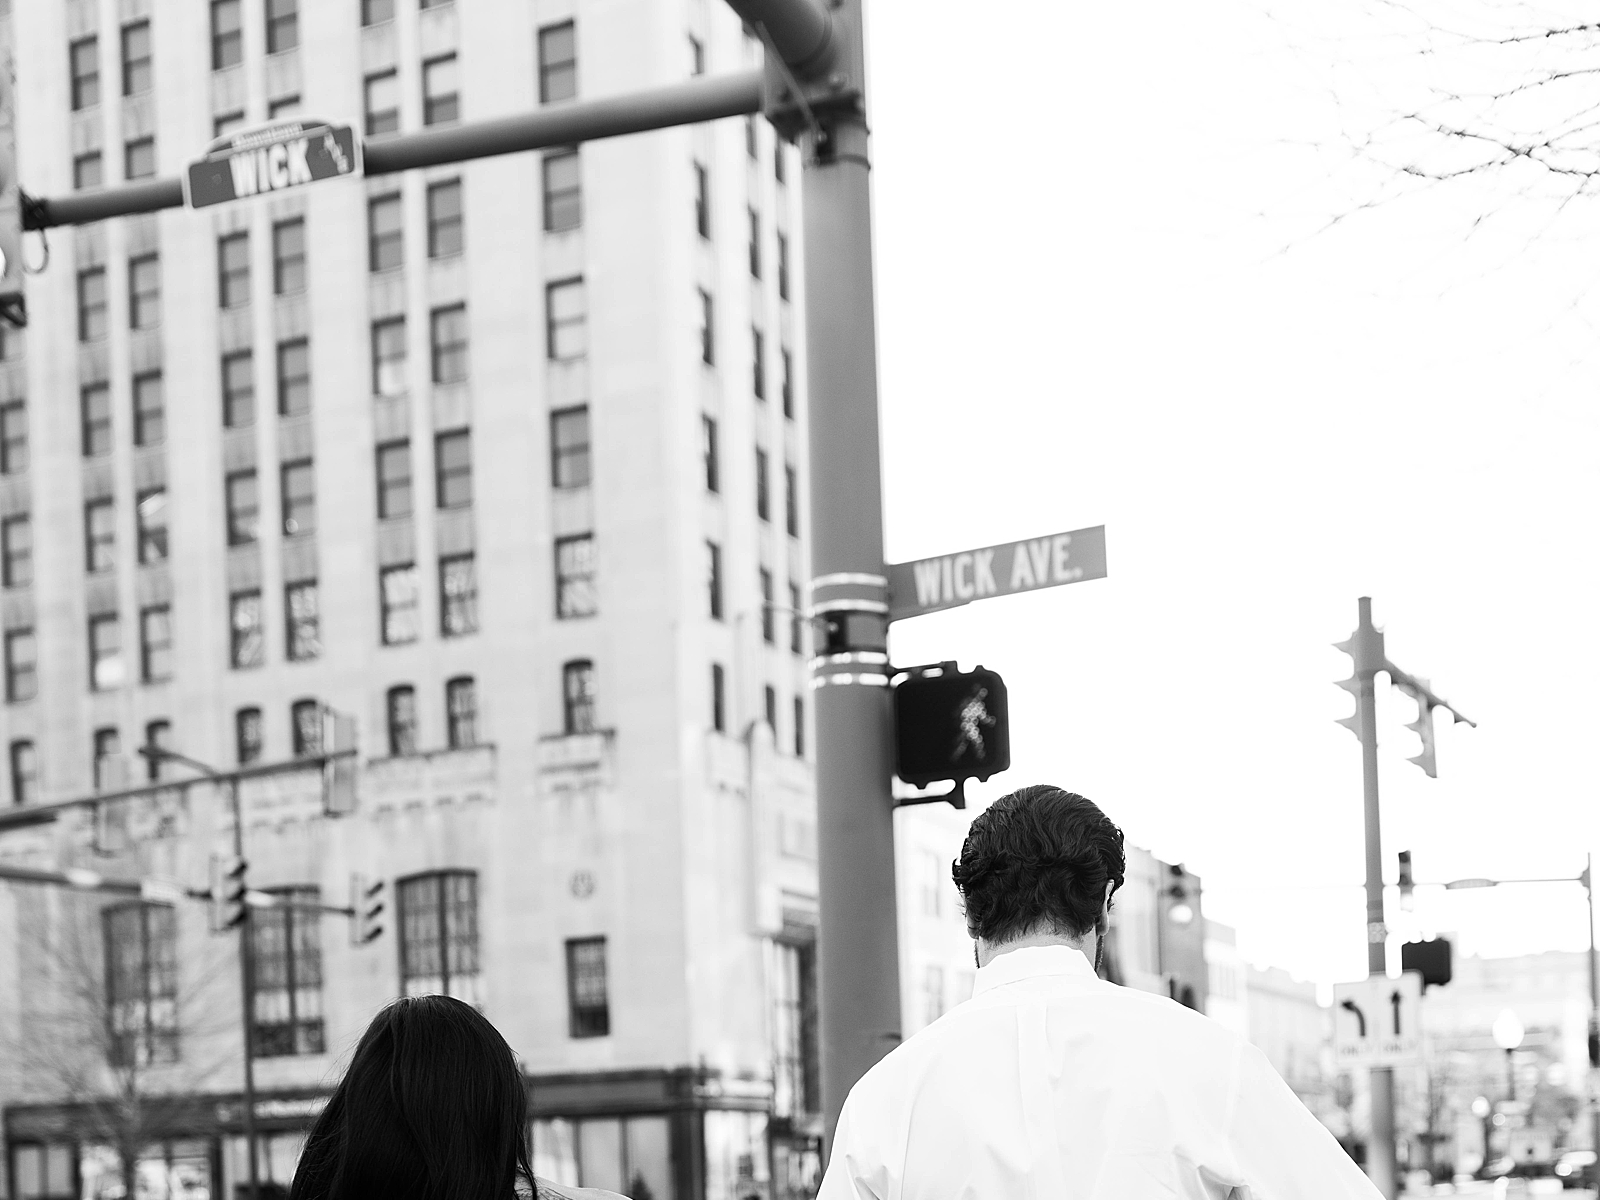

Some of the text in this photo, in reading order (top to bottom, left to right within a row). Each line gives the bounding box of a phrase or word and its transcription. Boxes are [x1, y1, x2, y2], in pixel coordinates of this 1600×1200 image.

[229, 137, 313, 198] WICK
[913, 534, 1083, 607] WICK AVE.
